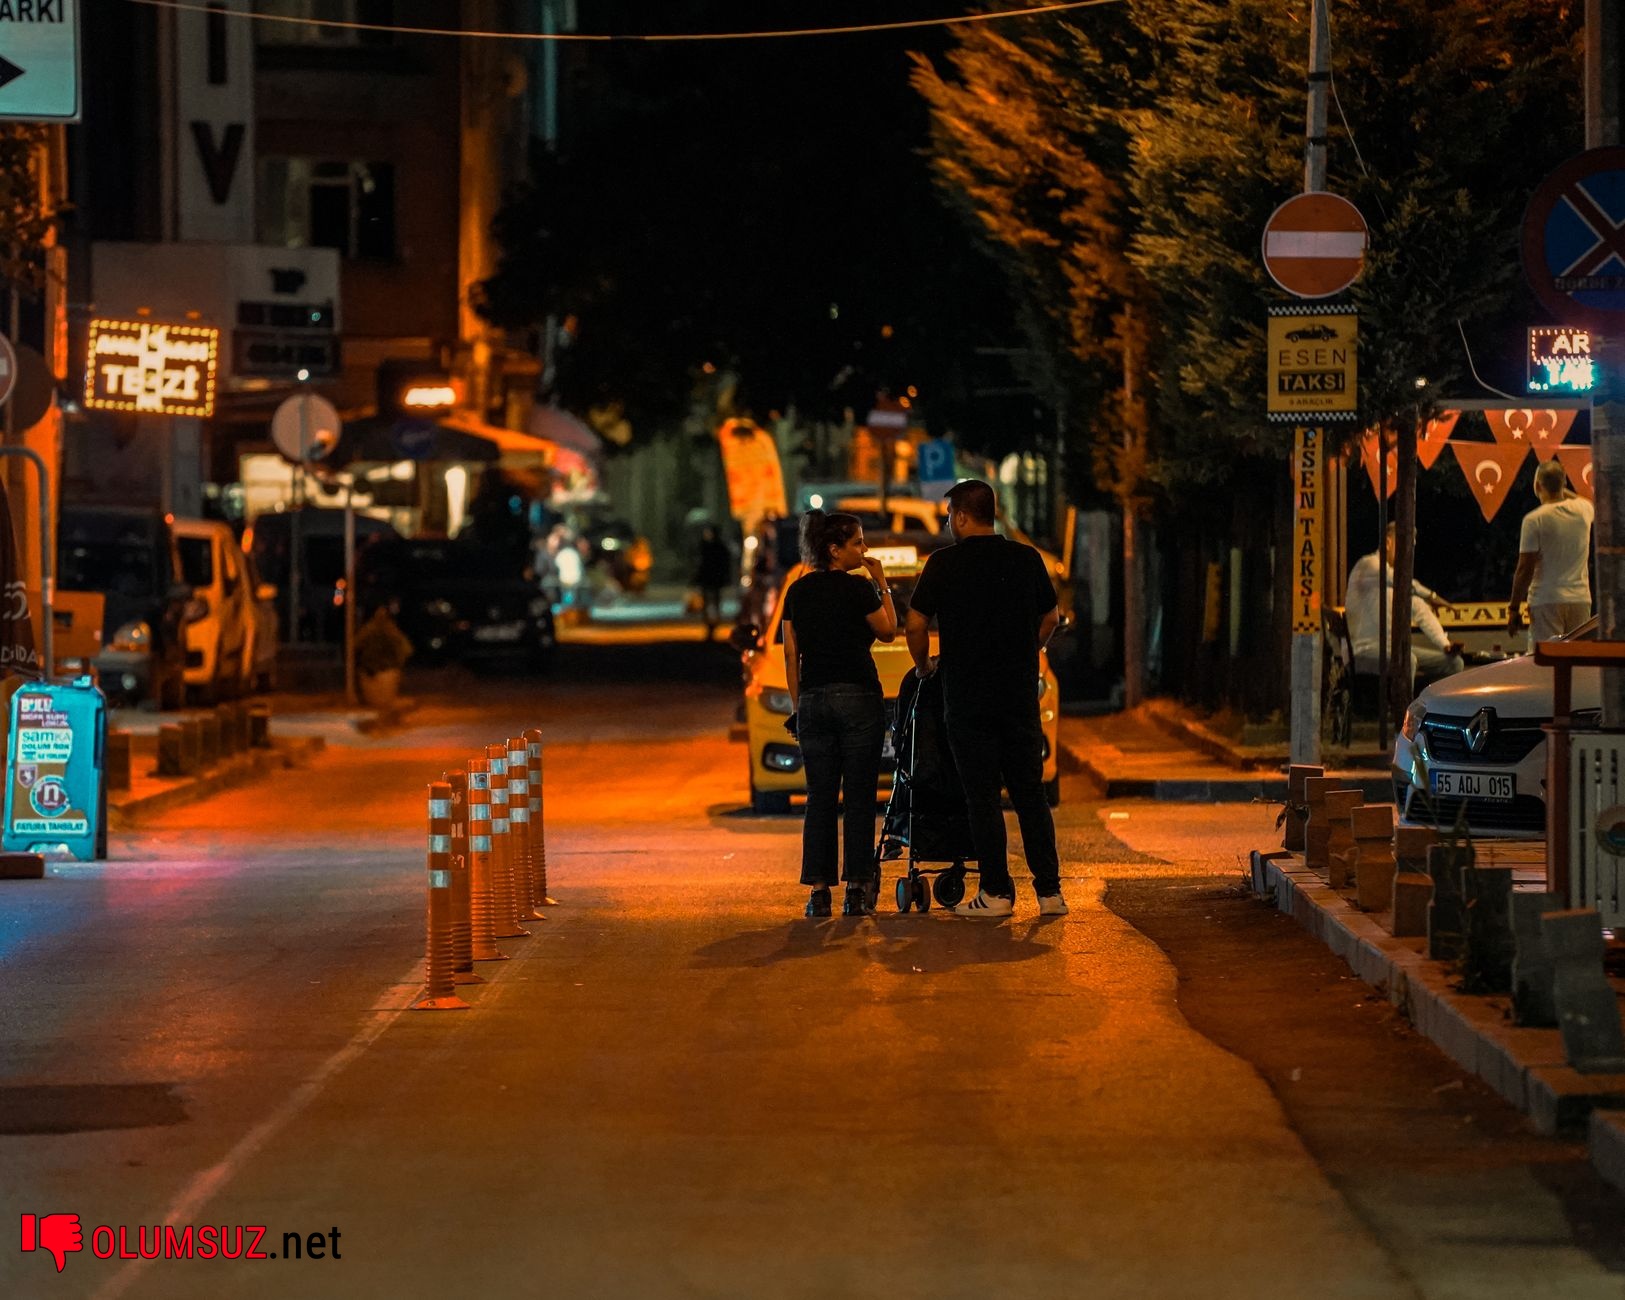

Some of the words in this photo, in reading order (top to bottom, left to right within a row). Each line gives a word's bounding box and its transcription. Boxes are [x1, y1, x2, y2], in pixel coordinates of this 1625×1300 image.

[1279, 348, 1347, 366] ESEN
[923, 442, 945, 478] P
[1299, 429, 1317, 509] ESEN
[1437, 774, 1451, 792] 55
[1489, 777, 1510, 796] 015
